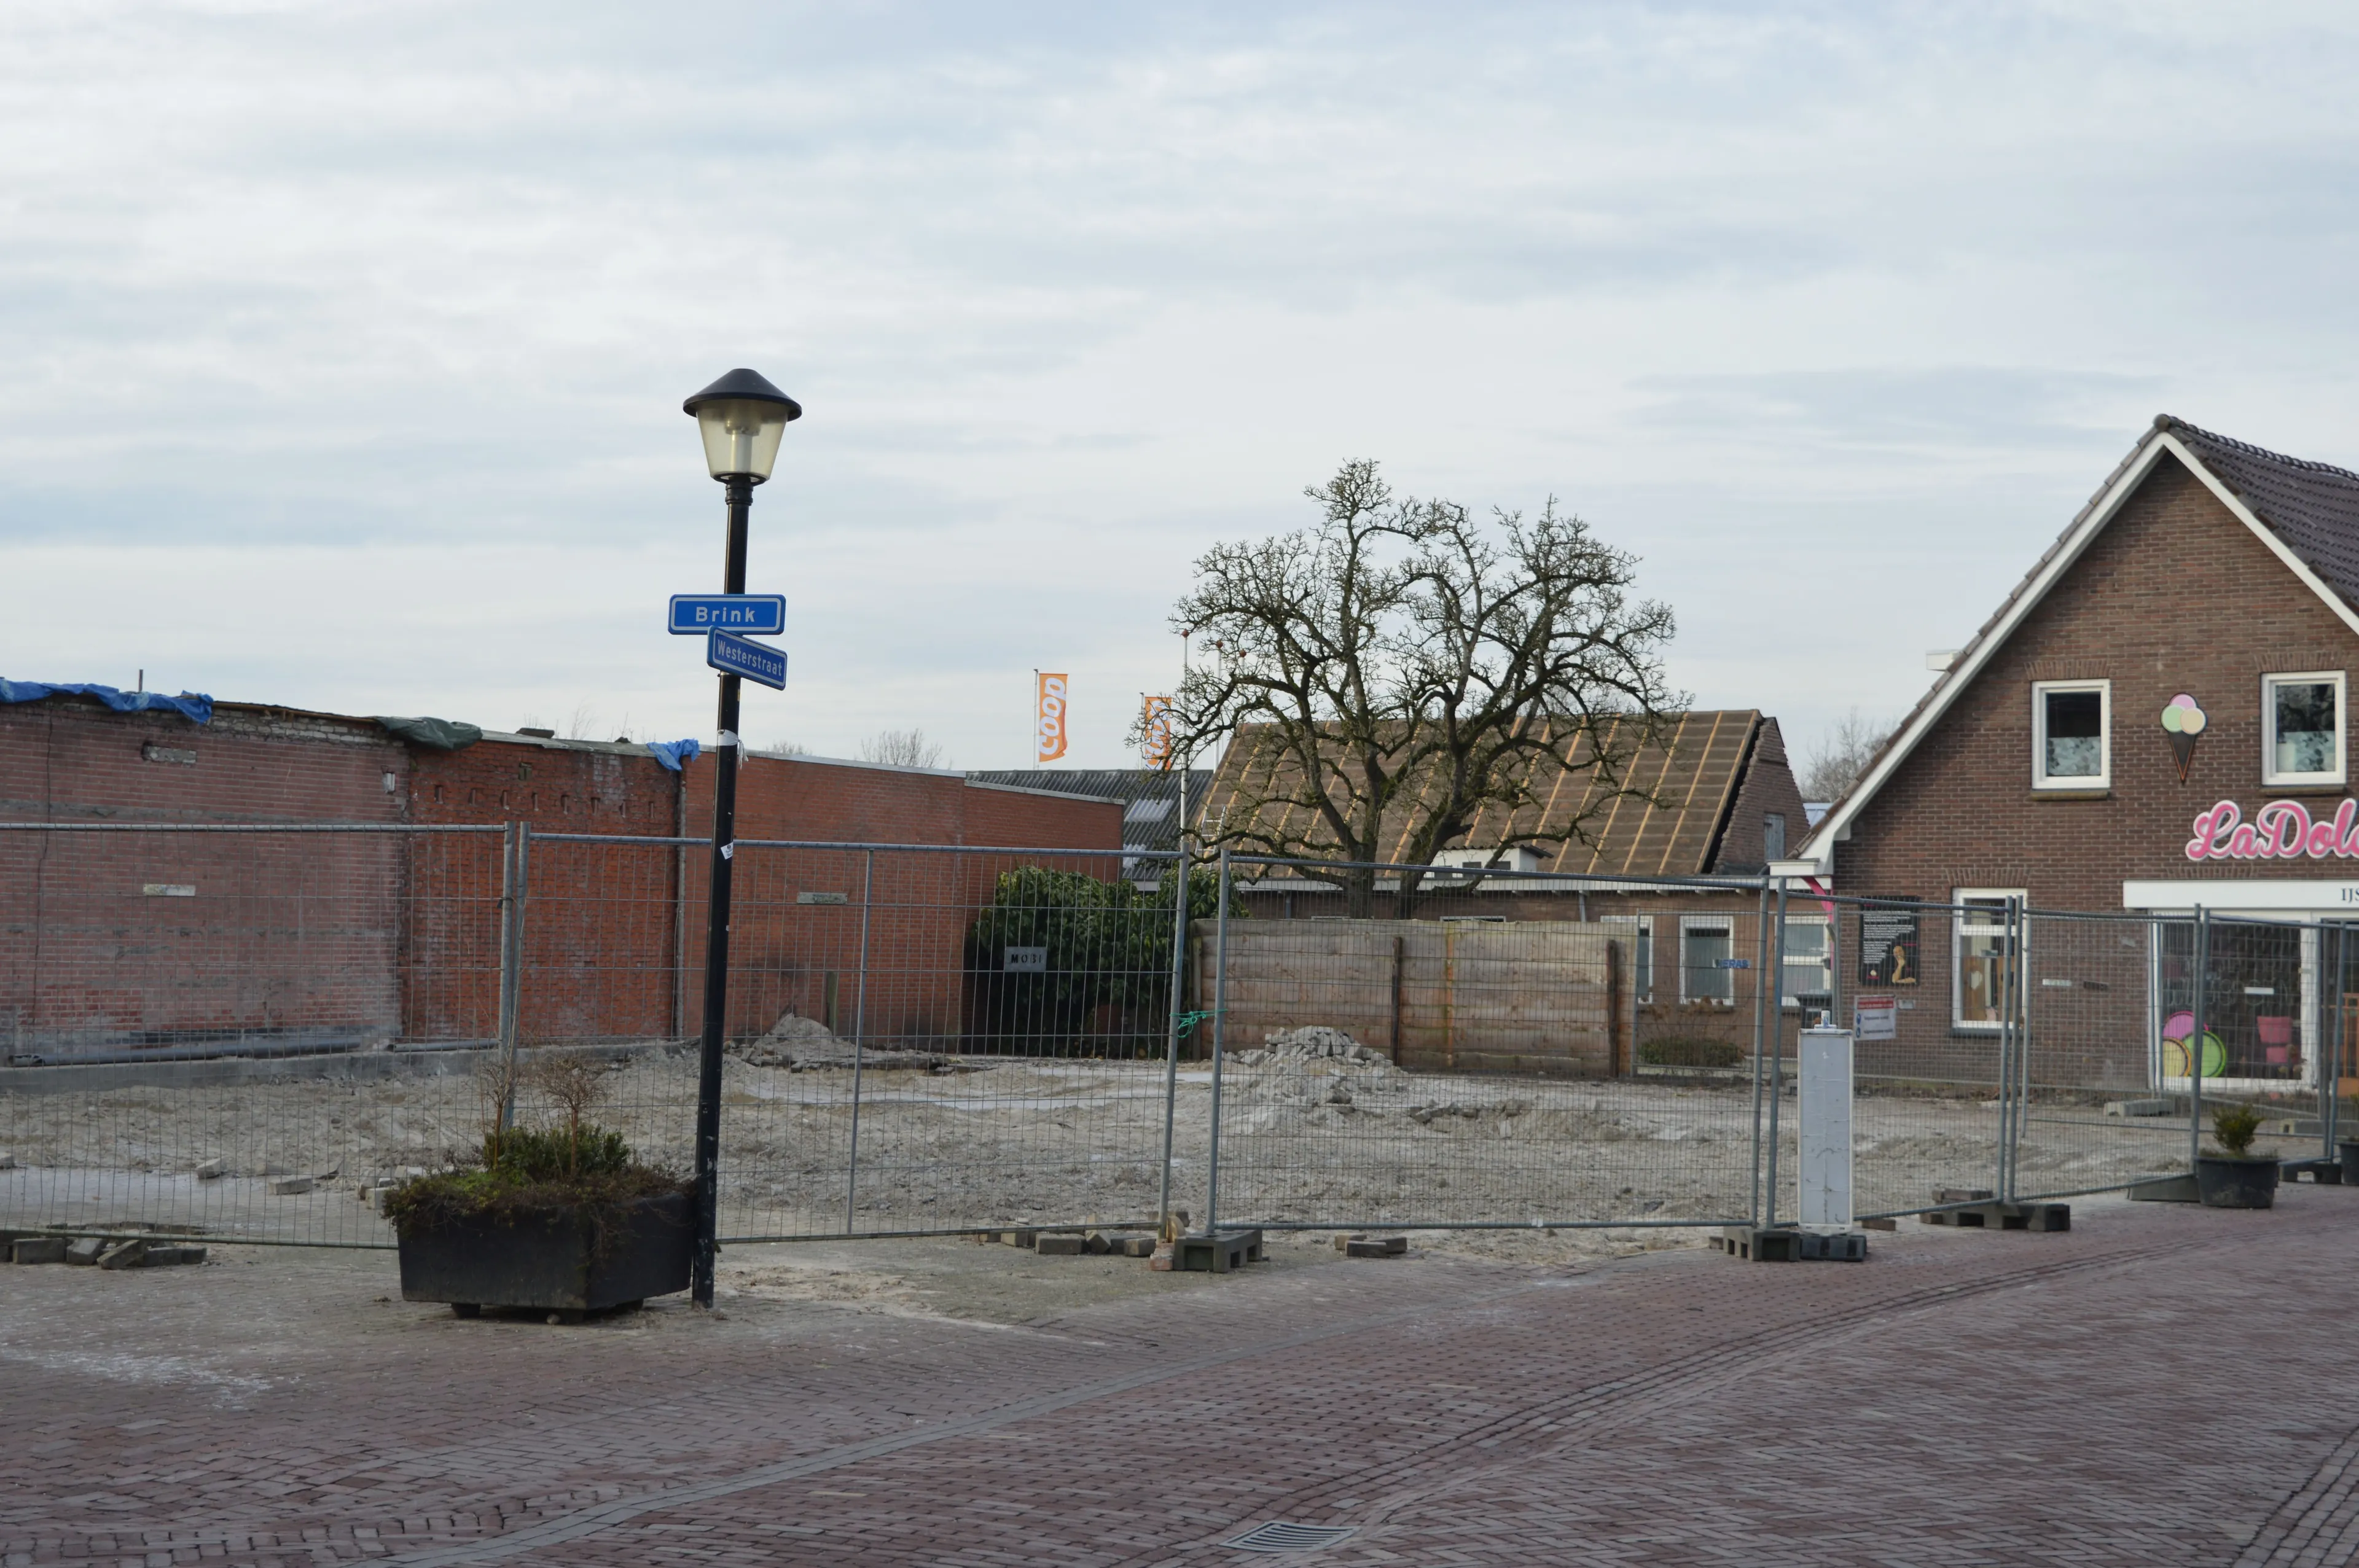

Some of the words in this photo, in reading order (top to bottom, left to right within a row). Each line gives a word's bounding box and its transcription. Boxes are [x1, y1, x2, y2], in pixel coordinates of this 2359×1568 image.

[695, 606, 756, 622] Brink
[718, 639, 783, 676] Westerstraat
[1039, 677, 1066, 755] coop
[1011, 953, 1042, 964] MOBI
